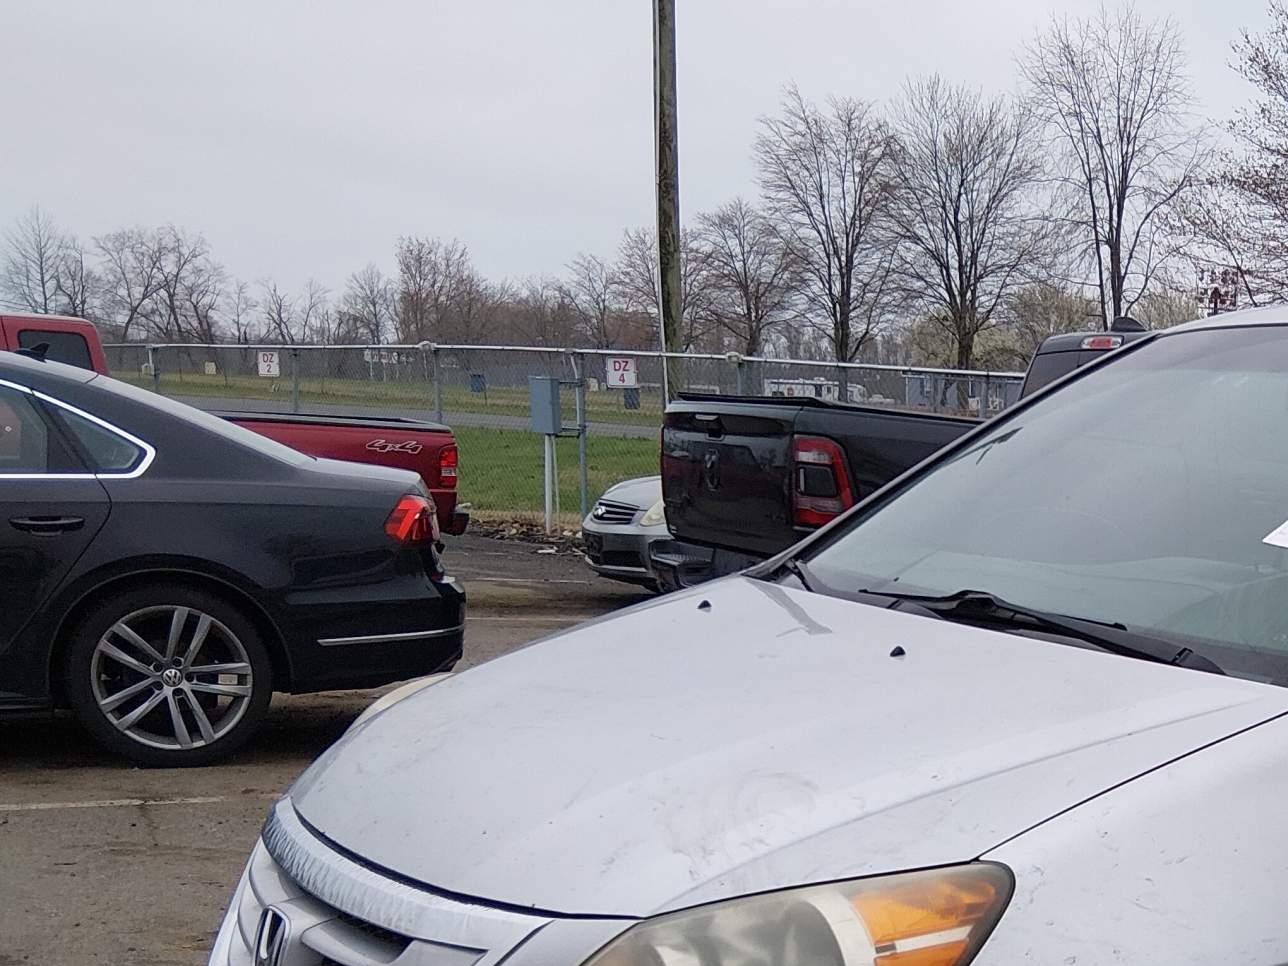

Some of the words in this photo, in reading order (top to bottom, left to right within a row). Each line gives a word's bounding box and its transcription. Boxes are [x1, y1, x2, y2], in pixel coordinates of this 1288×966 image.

[262, 352, 274, 363] DZ
[266, 364, 272, 373] 2
[613, 360, 630, 372] DZ
[618, 373, 626, 384] 4
